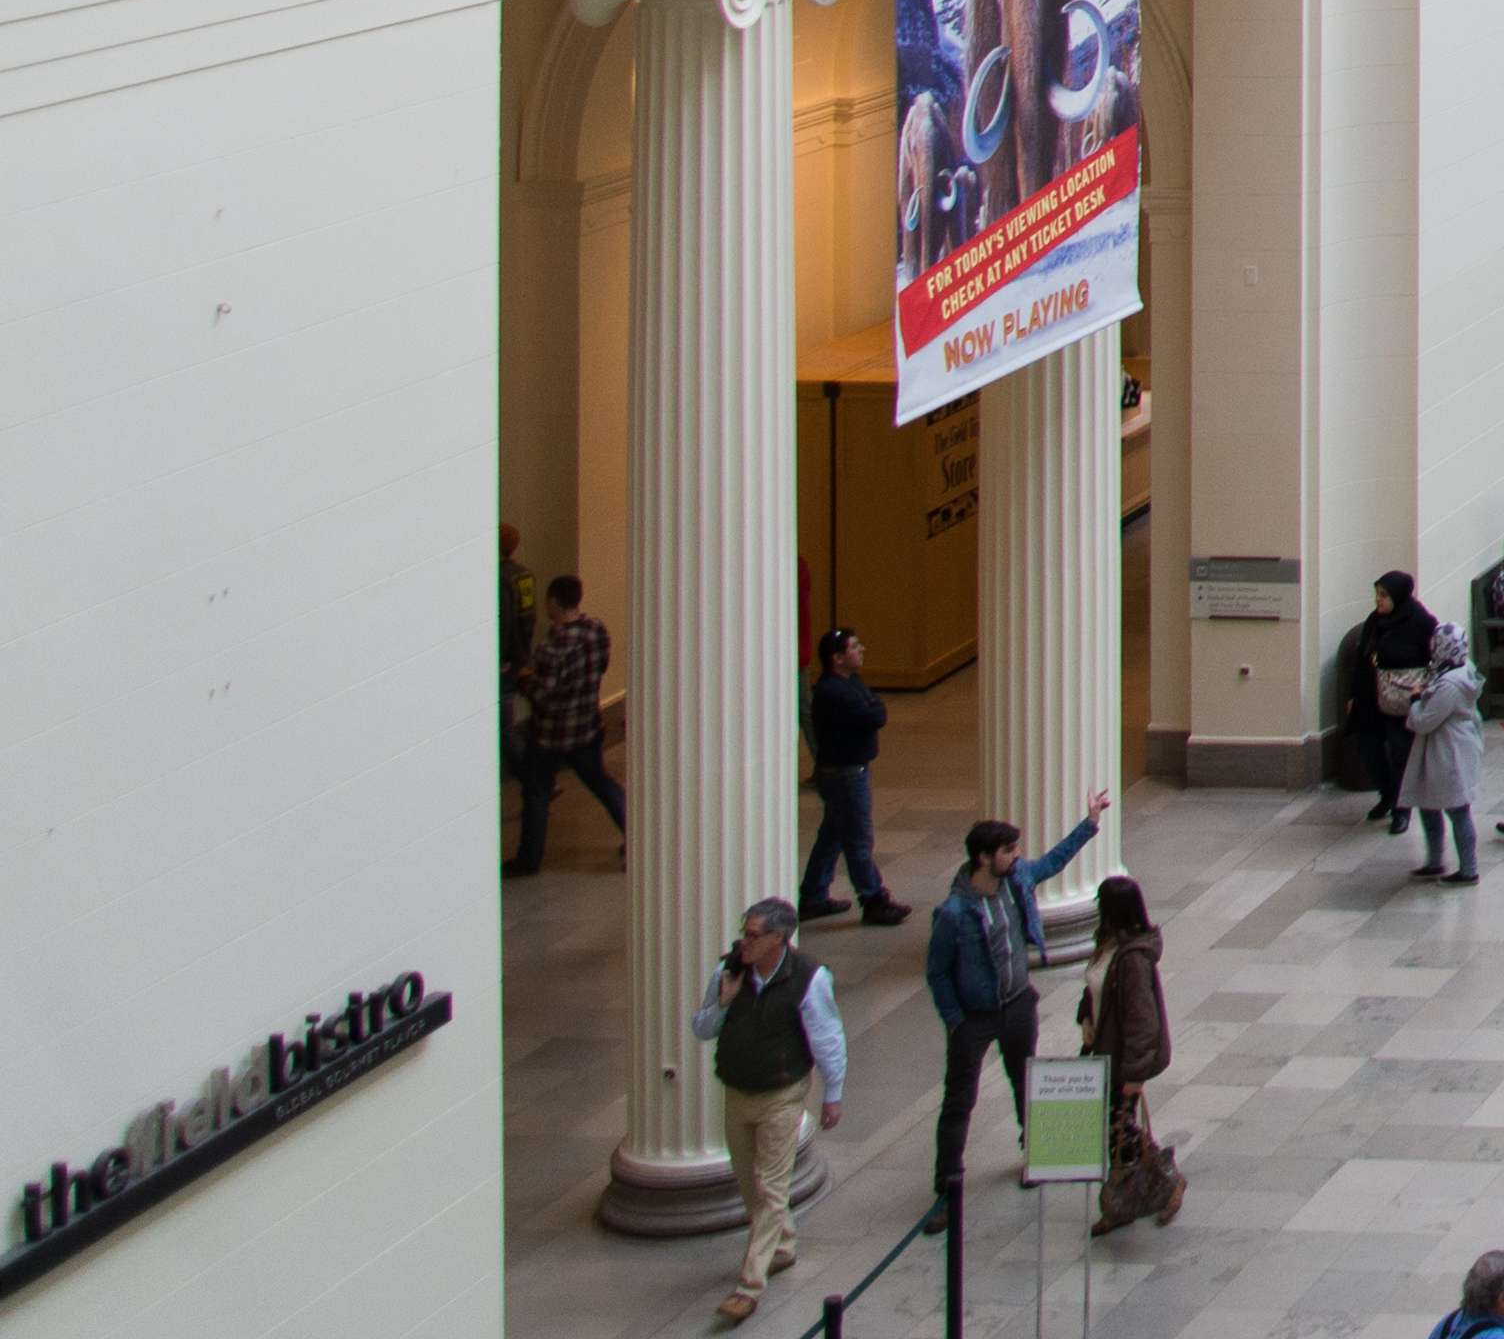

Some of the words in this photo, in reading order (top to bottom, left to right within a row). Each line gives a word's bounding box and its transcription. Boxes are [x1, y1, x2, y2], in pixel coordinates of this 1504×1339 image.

[926, 270, 953, 300] FOR
[954, 229, 1005, 278] TODAY'S
[1006, 192, 1058, 241] VIEWING
[1060, 149, 1116, 204] LOCATION
[941, 277, 985, 320] CHECK
[986, 259, 1003, 287] AT
[1004, 240, 1028, 273] ANY
[1029, 210, 1072, 256] TICKET
[1074, 184, 1106, 218] DESK
[944, 320, 995, 373] NOW
[1003, 279, 1089, 346] PLAYING
[942, 453, 977, 494] Store
[19, 1145, 131, 1243] the
[269, 971, 425, 1095] bistro
[1044, 1074, 1065, 1083] Thank
[1068, 1076, 1081, 1084] you
[1083, 1074, 1095, 1083] for
[1075, 1085, 1096, 1094] today
